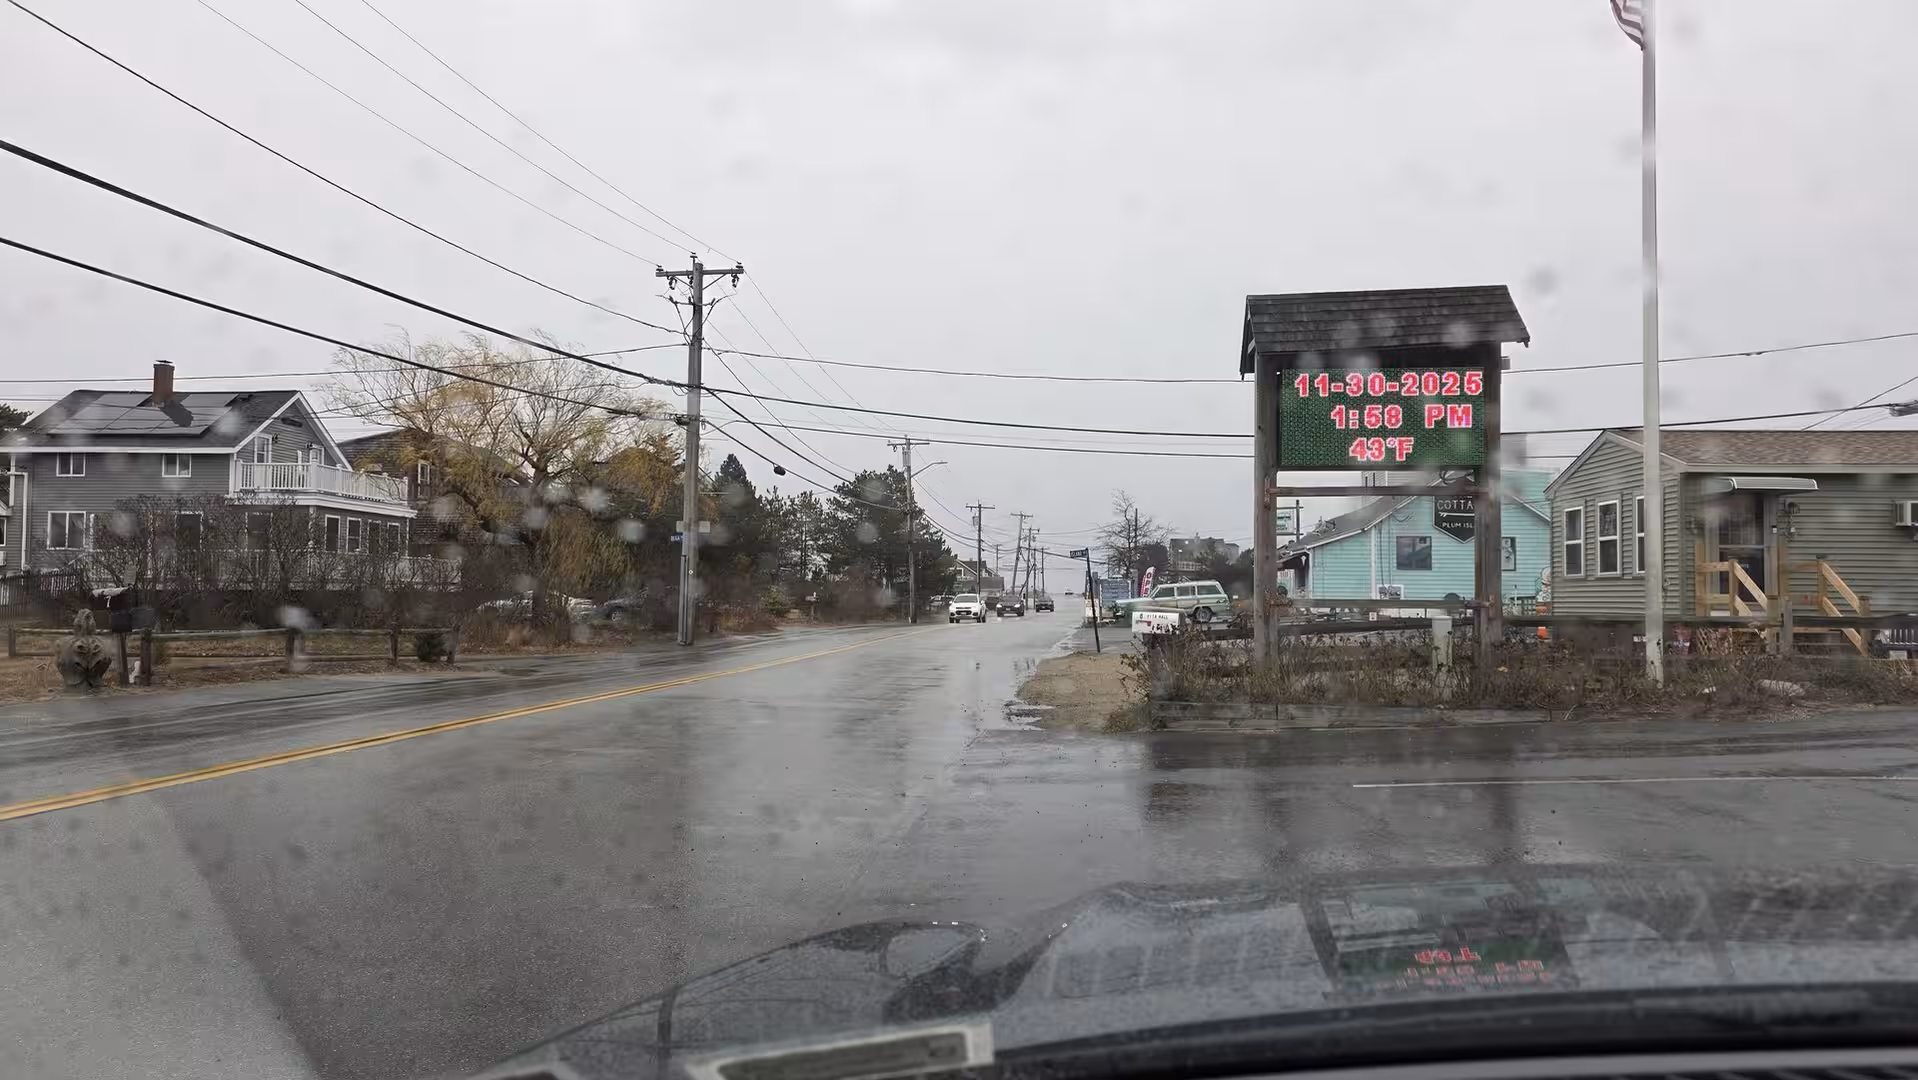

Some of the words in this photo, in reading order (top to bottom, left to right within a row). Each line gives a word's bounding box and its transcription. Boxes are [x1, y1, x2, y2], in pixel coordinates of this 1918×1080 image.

[1294, 371, 1483, 397] 11-30-2025
[1330, 404, 1402, 429] 1:58
[1424, 404, 1472, 428] PM
[1349, 437, 1414, 461] 43°F
[1437, 500, 1474, 510] COTTA
